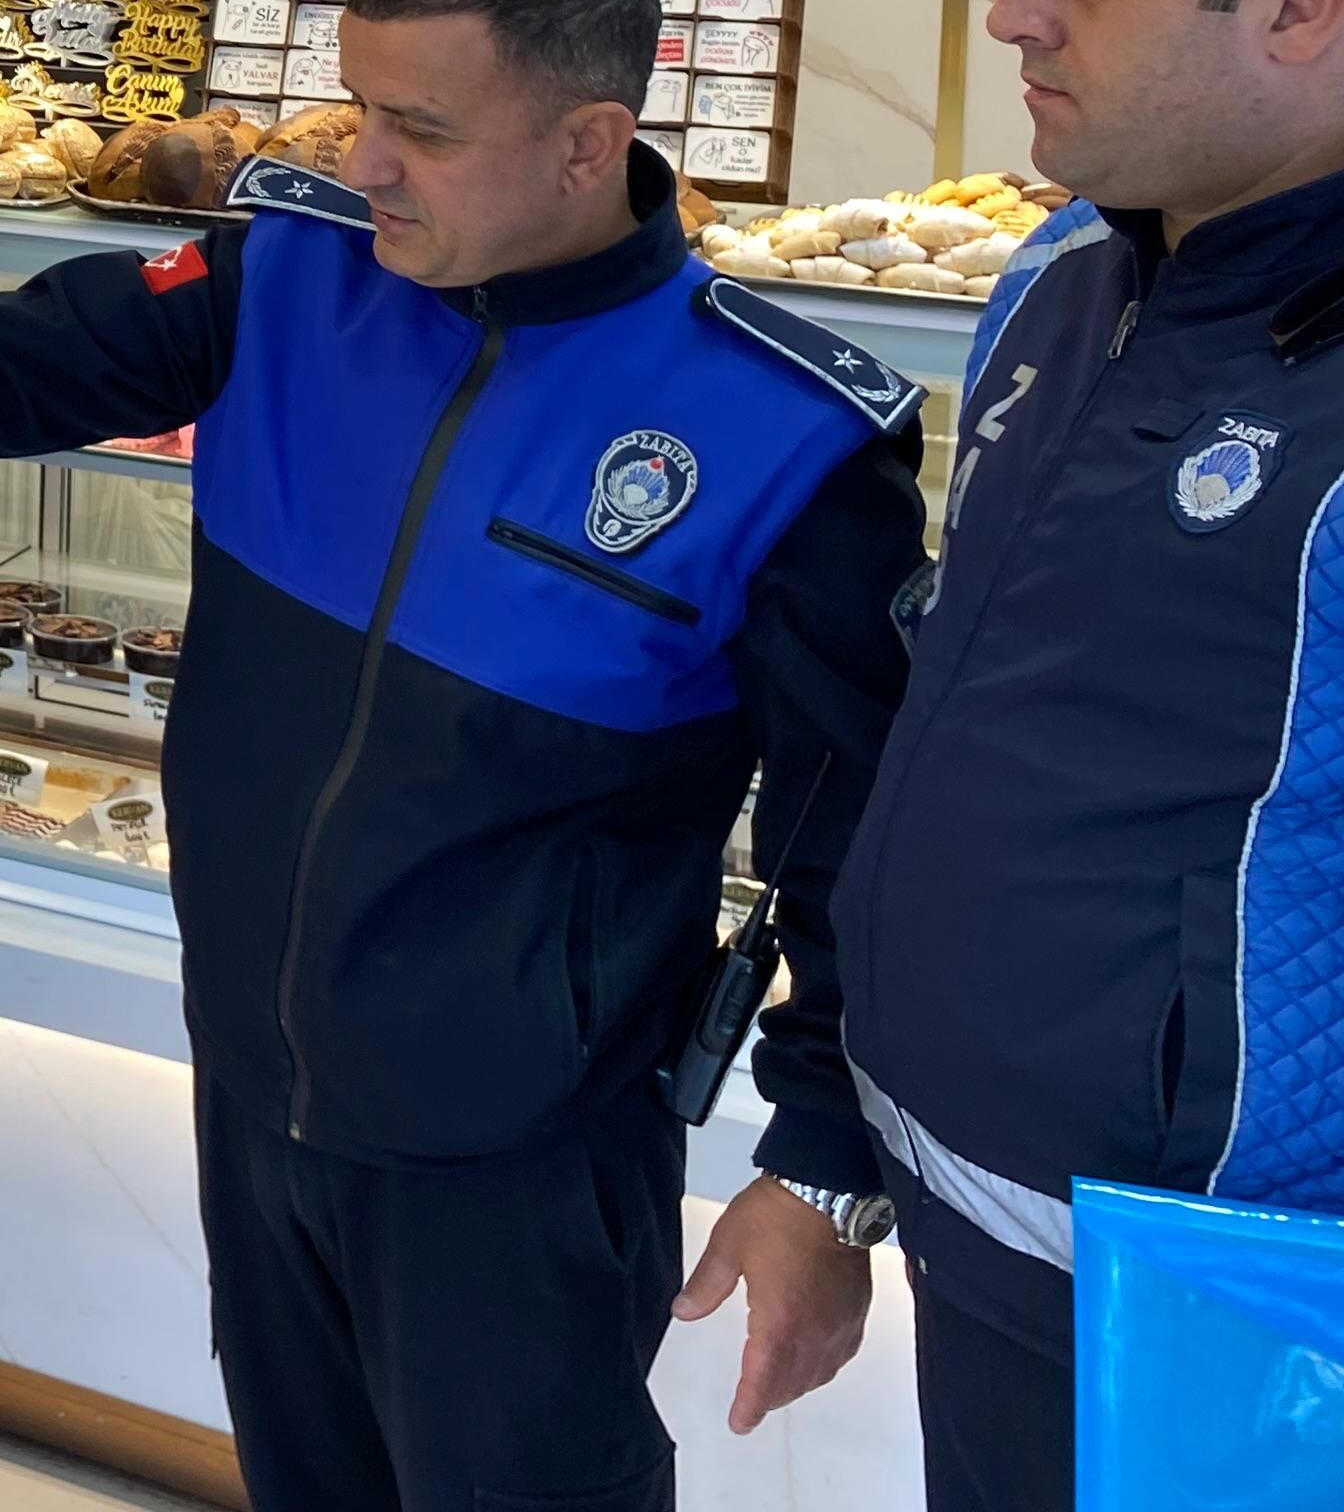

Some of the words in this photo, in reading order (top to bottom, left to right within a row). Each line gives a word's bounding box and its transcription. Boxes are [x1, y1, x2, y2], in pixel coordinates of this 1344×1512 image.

[124, 3, 201, 36] Happy
[255, 5, 280, 22] SİZ
[113, 28, 205, 61] Birthday
[243, 70, 279, 80] YALVAR
[732, 137, 756, 147] SEN
[1217, 416, 1280, 451] ZABITA
[639, 433, 693, 473] ZABITA
